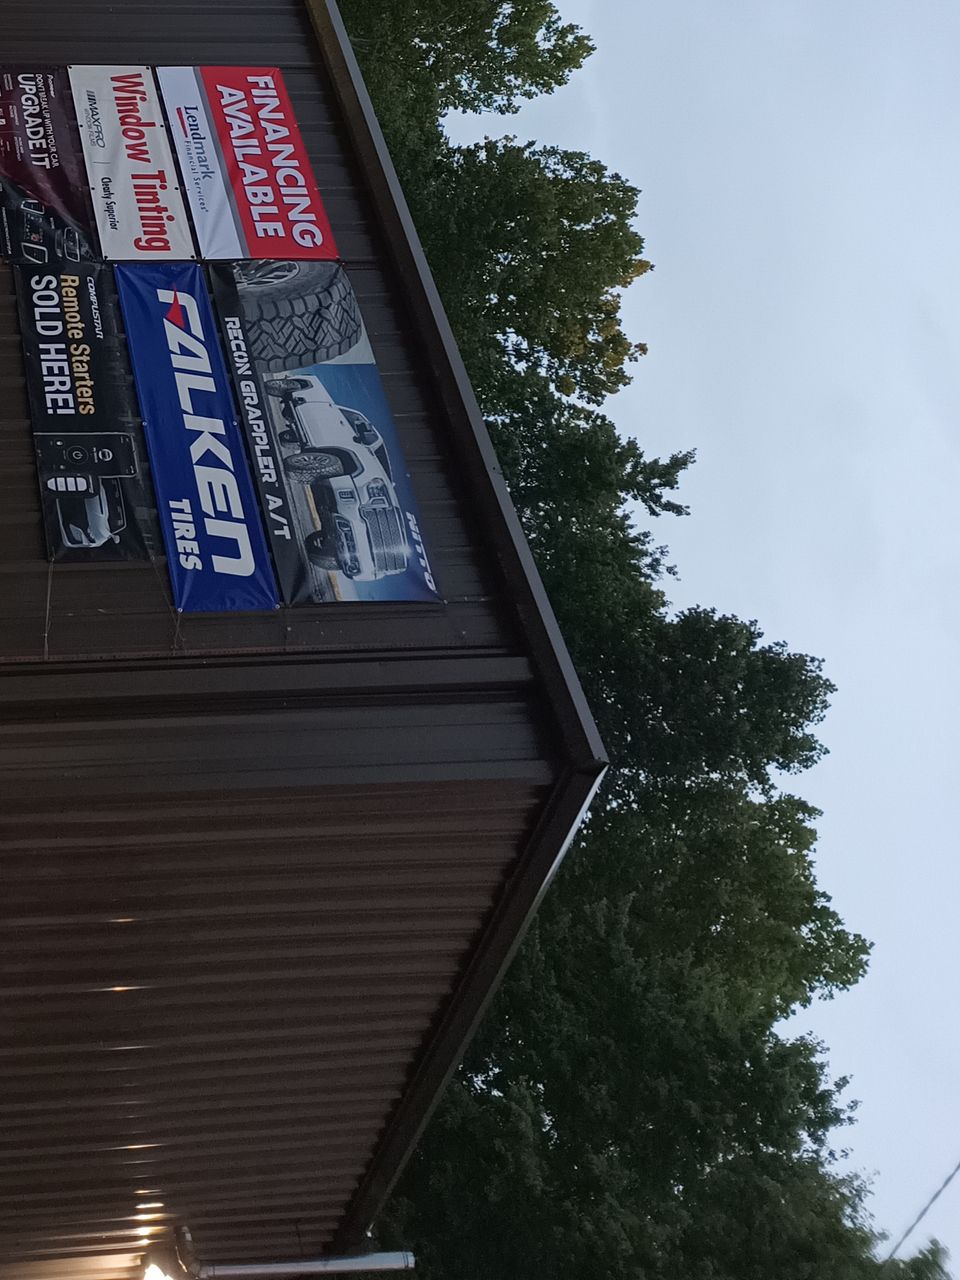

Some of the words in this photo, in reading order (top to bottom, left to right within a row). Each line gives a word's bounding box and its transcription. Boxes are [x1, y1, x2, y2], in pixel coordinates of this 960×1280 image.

[17, 73, 47, 150] UPGRADE
[42, 109, 50, 118] UP
[44, 118, 53, 136] WITH
[46, 135, 57, 153] YOUR
[110, 73, 156, 163] Window
[184, 105, 215, 180] Lendmark
[30, 153, 51, 169] IT
[50, 153, 59, 168] CAR
[101, 177, 114, 199] Clearly
[184, 140, 199, 174] Financial
[192, 177, 208, 211] Services
[216, 84, 286, 238] AVAILABLE
[247, 75, 323, 248] FINANCING
[104, 202, 118, 230] Superior
[130, 169, 175, 251] Tinting
[30, 274, 63, 336] SOLD
[59, 273, 87, 340] Remote
[86, 276, 105, 339] COMPUSTAR
[38, 343, 75, 415] HERE!
[70, 343, 97, 415] Starters
[156, 288, 256, 577] FALKEN
[224, 317, 252, 375] RECON
[239, 380, 277, 484] GRAPPLER
[265, 494, 291, 540] A/T
[168, 498, 203, 571] TIRES
[405, 511, 438, 594] NITTO
